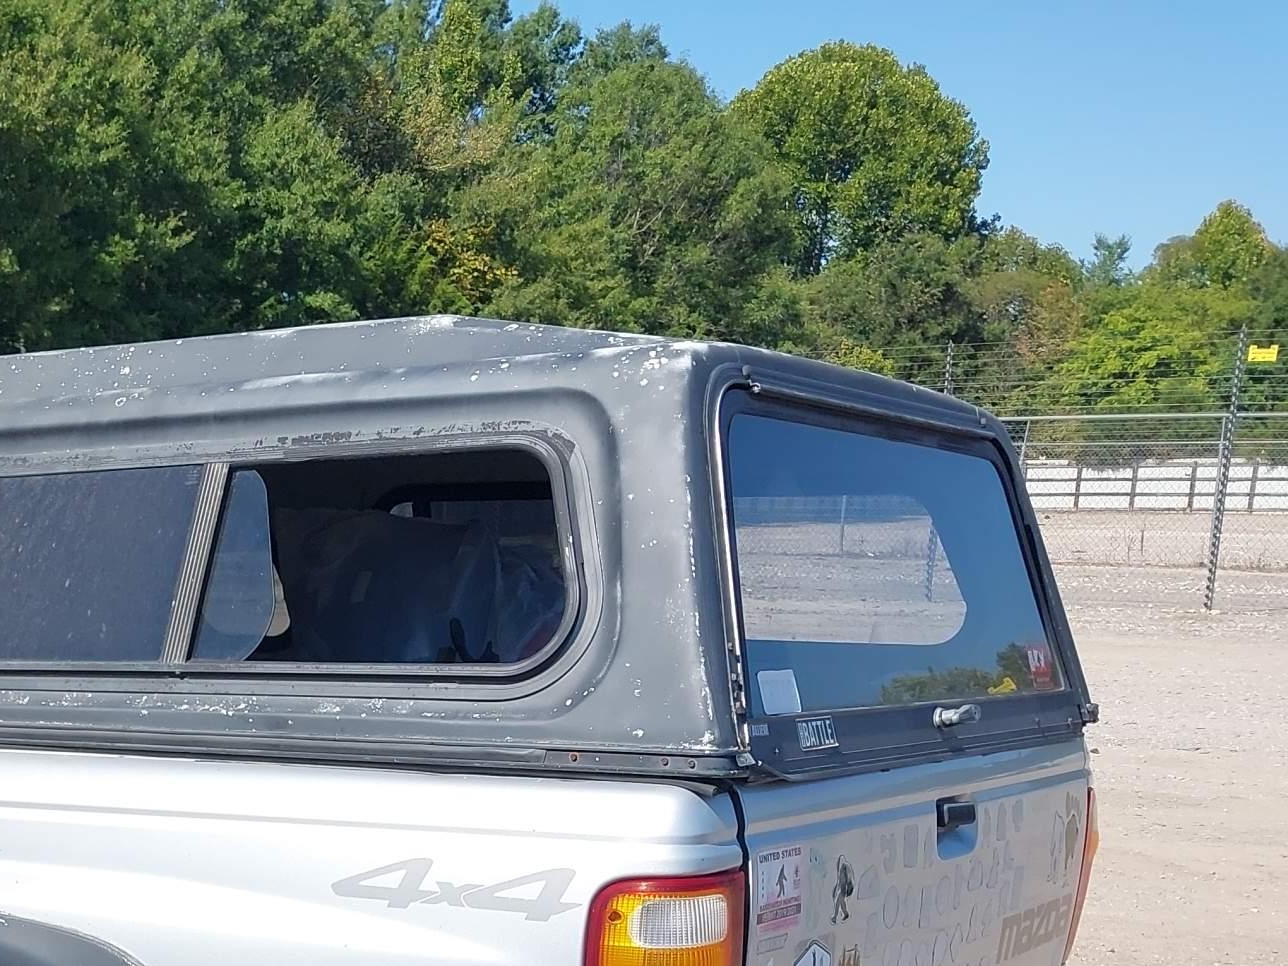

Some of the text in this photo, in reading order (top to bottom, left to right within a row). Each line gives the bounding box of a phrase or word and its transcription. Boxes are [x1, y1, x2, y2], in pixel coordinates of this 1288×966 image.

[802, 720, 834, 746] BATTLE
[758, 847, 802, 864] UNITED STATES
[330, 857, 583, 922] 4x4
